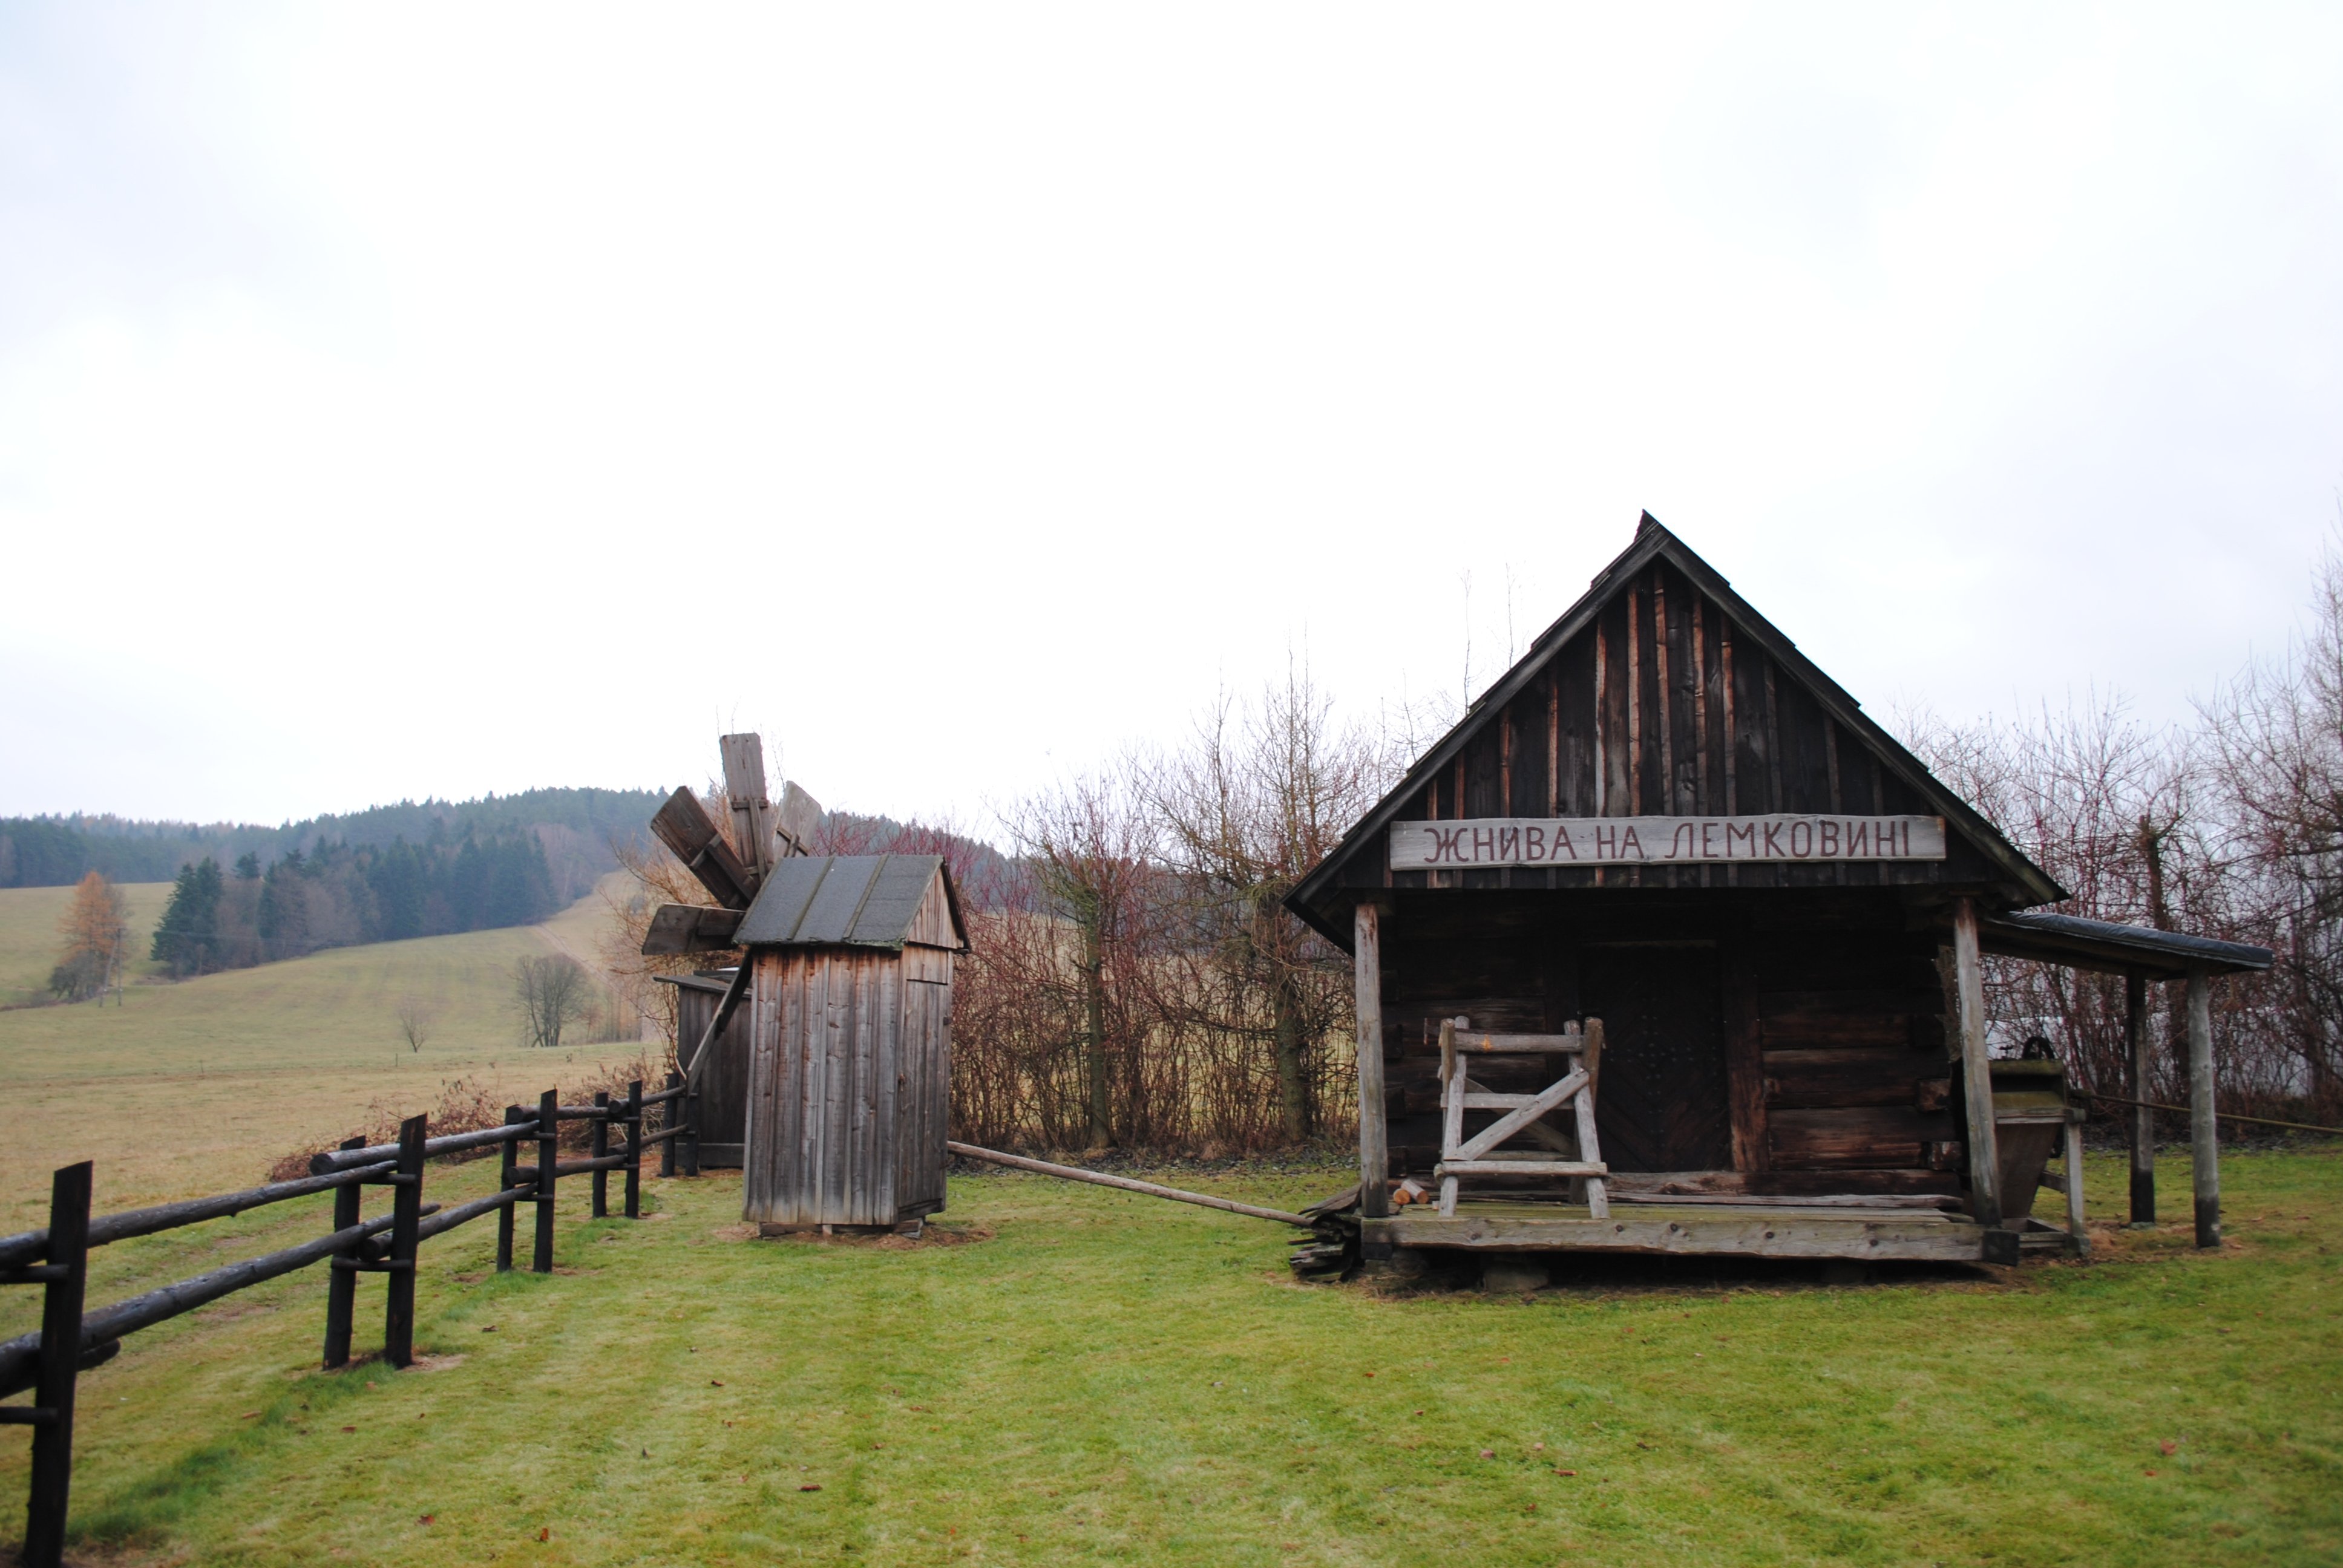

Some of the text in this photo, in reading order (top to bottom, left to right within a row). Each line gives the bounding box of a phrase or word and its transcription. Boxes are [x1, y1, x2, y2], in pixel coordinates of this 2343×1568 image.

[1423, 820, 1909, 863] ЖНИВА НА ЛЕМКОВИНІ
